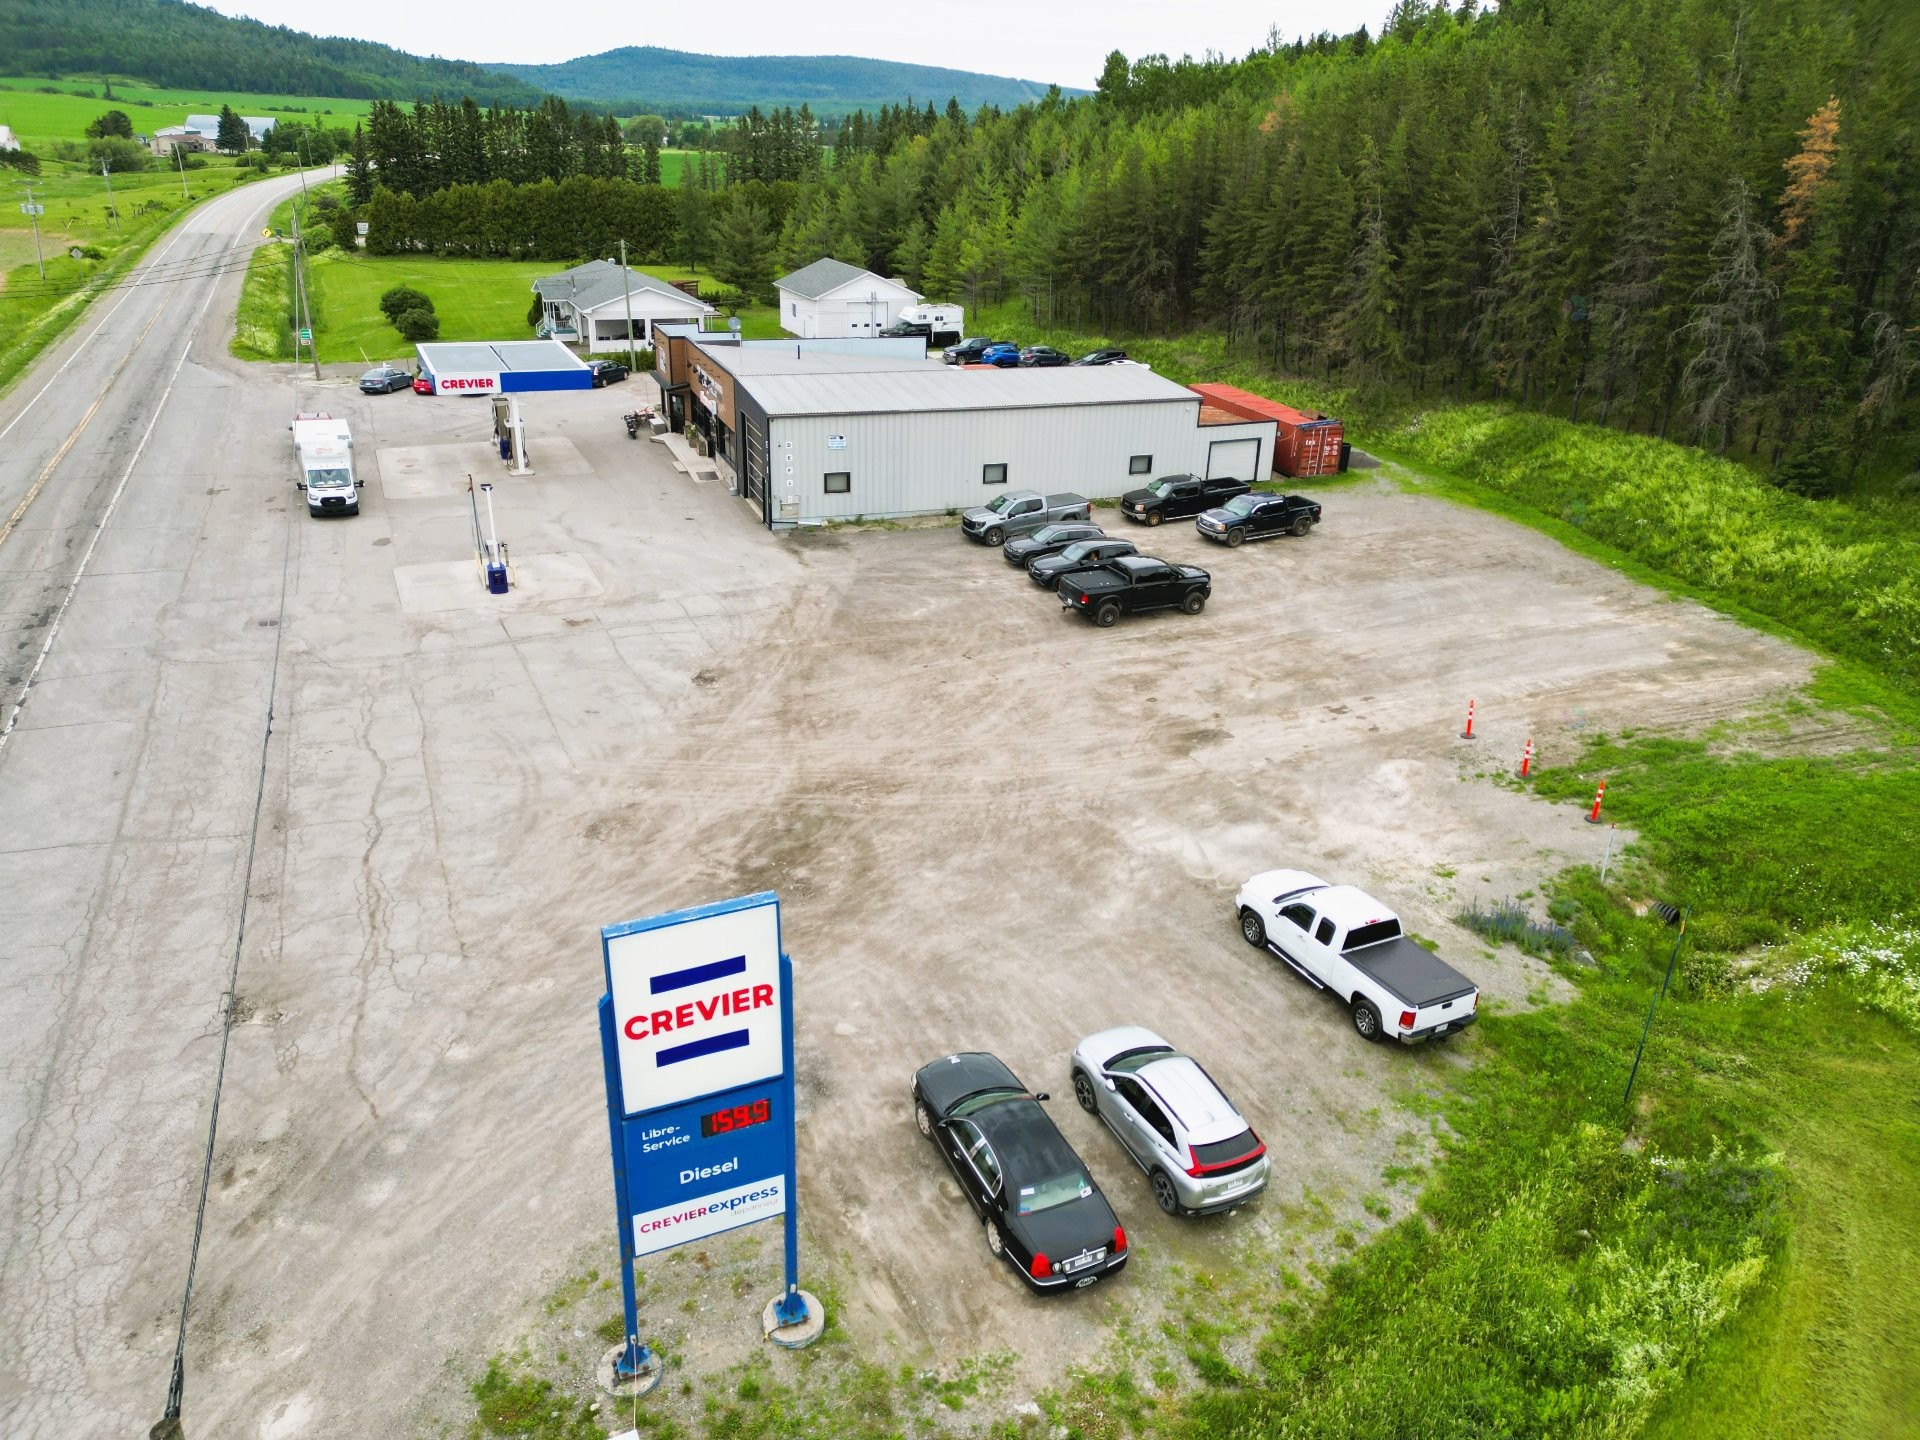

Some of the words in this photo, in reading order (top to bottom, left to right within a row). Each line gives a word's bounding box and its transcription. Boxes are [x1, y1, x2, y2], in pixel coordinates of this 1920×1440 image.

[441, 378, 494, 390] CREVIER
[624, 984, 774, 1041] CREVIER
[711, 1099, 768, 1132] 159.9
[642, 1126, 681, 1141] Libre-
[642, 1134, 691, 1153] Service
[679, 1156, 739, 1185] Diesel
